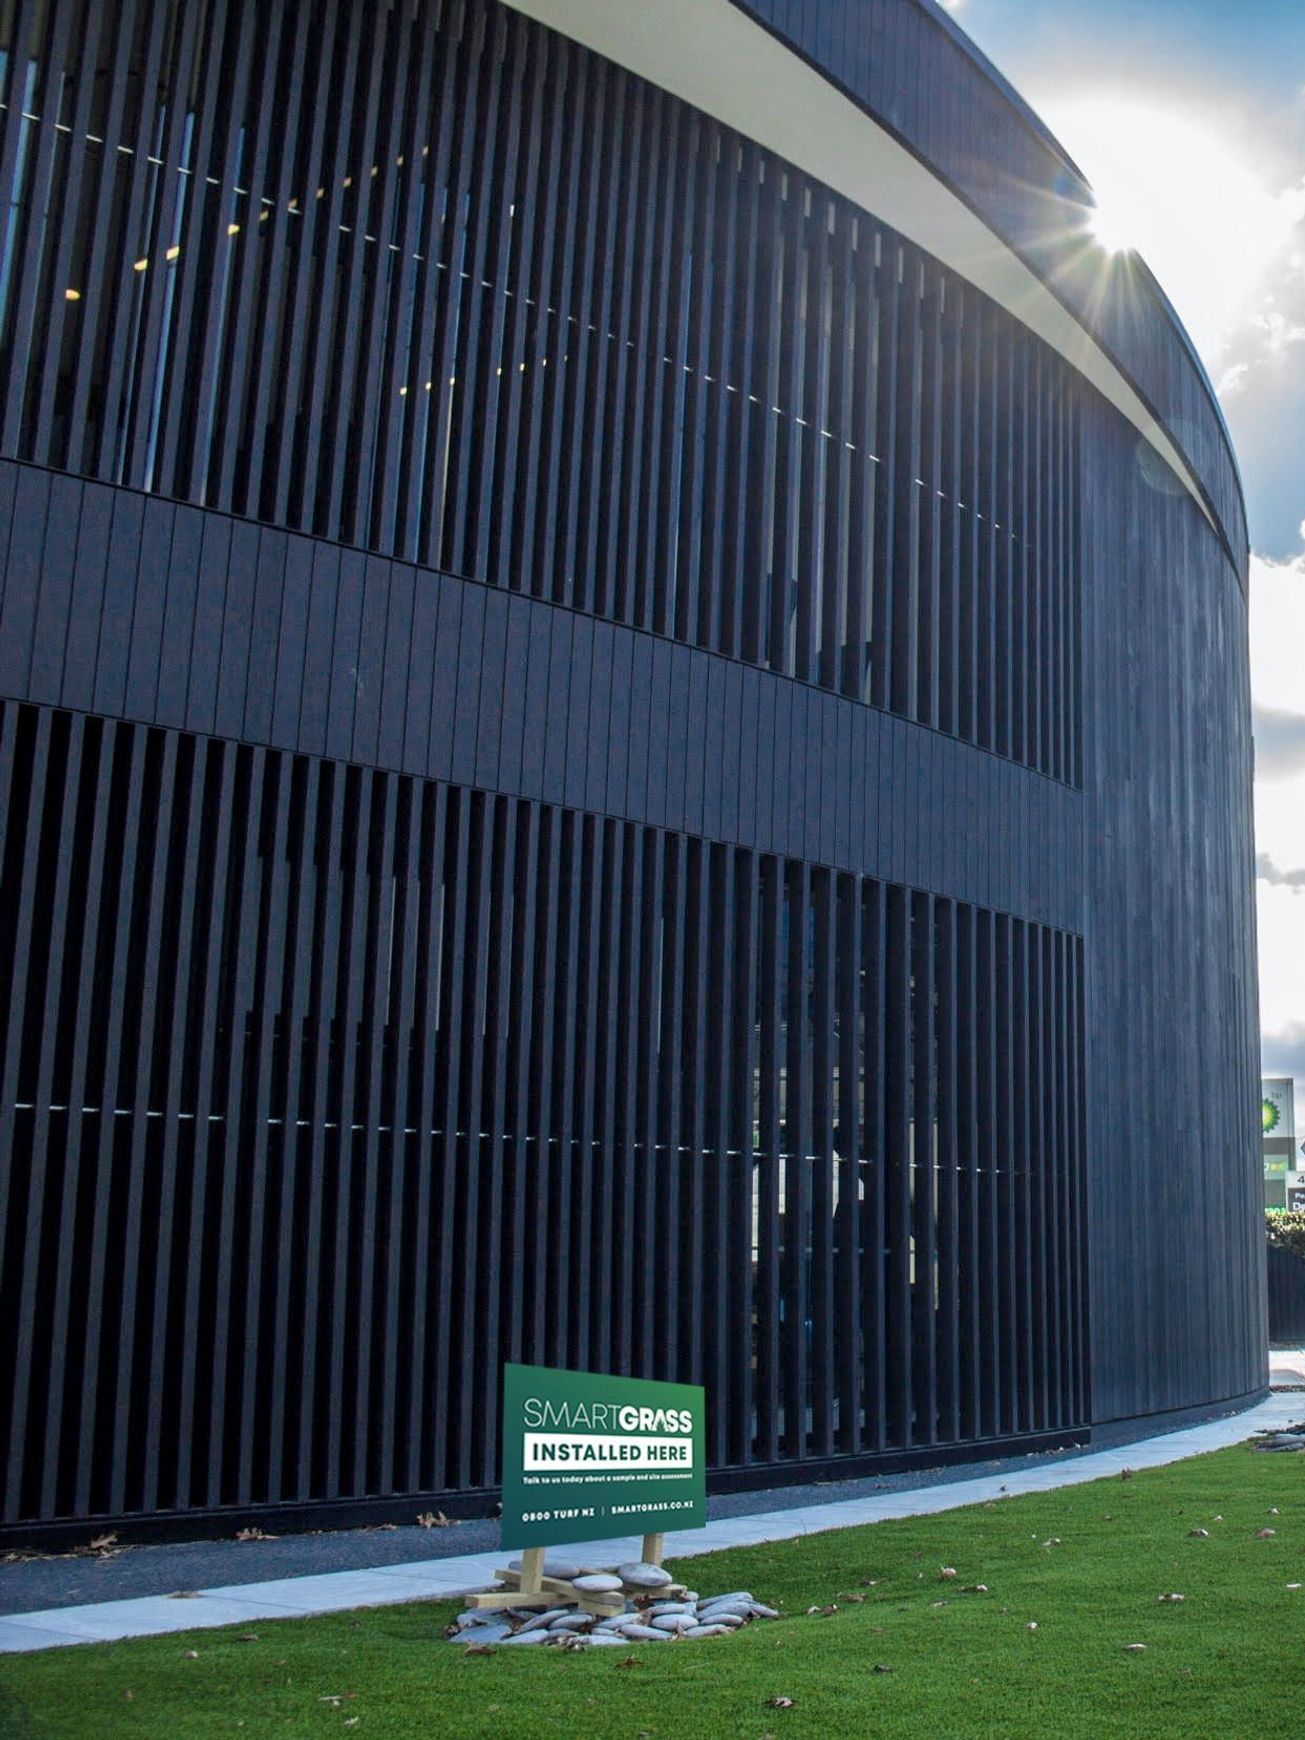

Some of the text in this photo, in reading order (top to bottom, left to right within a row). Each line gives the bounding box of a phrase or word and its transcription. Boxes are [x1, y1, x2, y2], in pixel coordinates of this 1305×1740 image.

[524, 1398, 693, 1433] SMARTGRASS
[533, 1443, 687, 1461] INSTALLED HERE
[523, 1476, 540, 1485] Talk
[541, 1476, 550, 1484] to
[562, 1475, 583, 1485] today
[585, 1474, 606, 1483] about
[612, 1474, 635, 1483] sample
[636, 1473, 648, 1481] and
[522, 1500, 694, 1522] 0800 TURF NZ SMARTGRASS.CO.NZ
